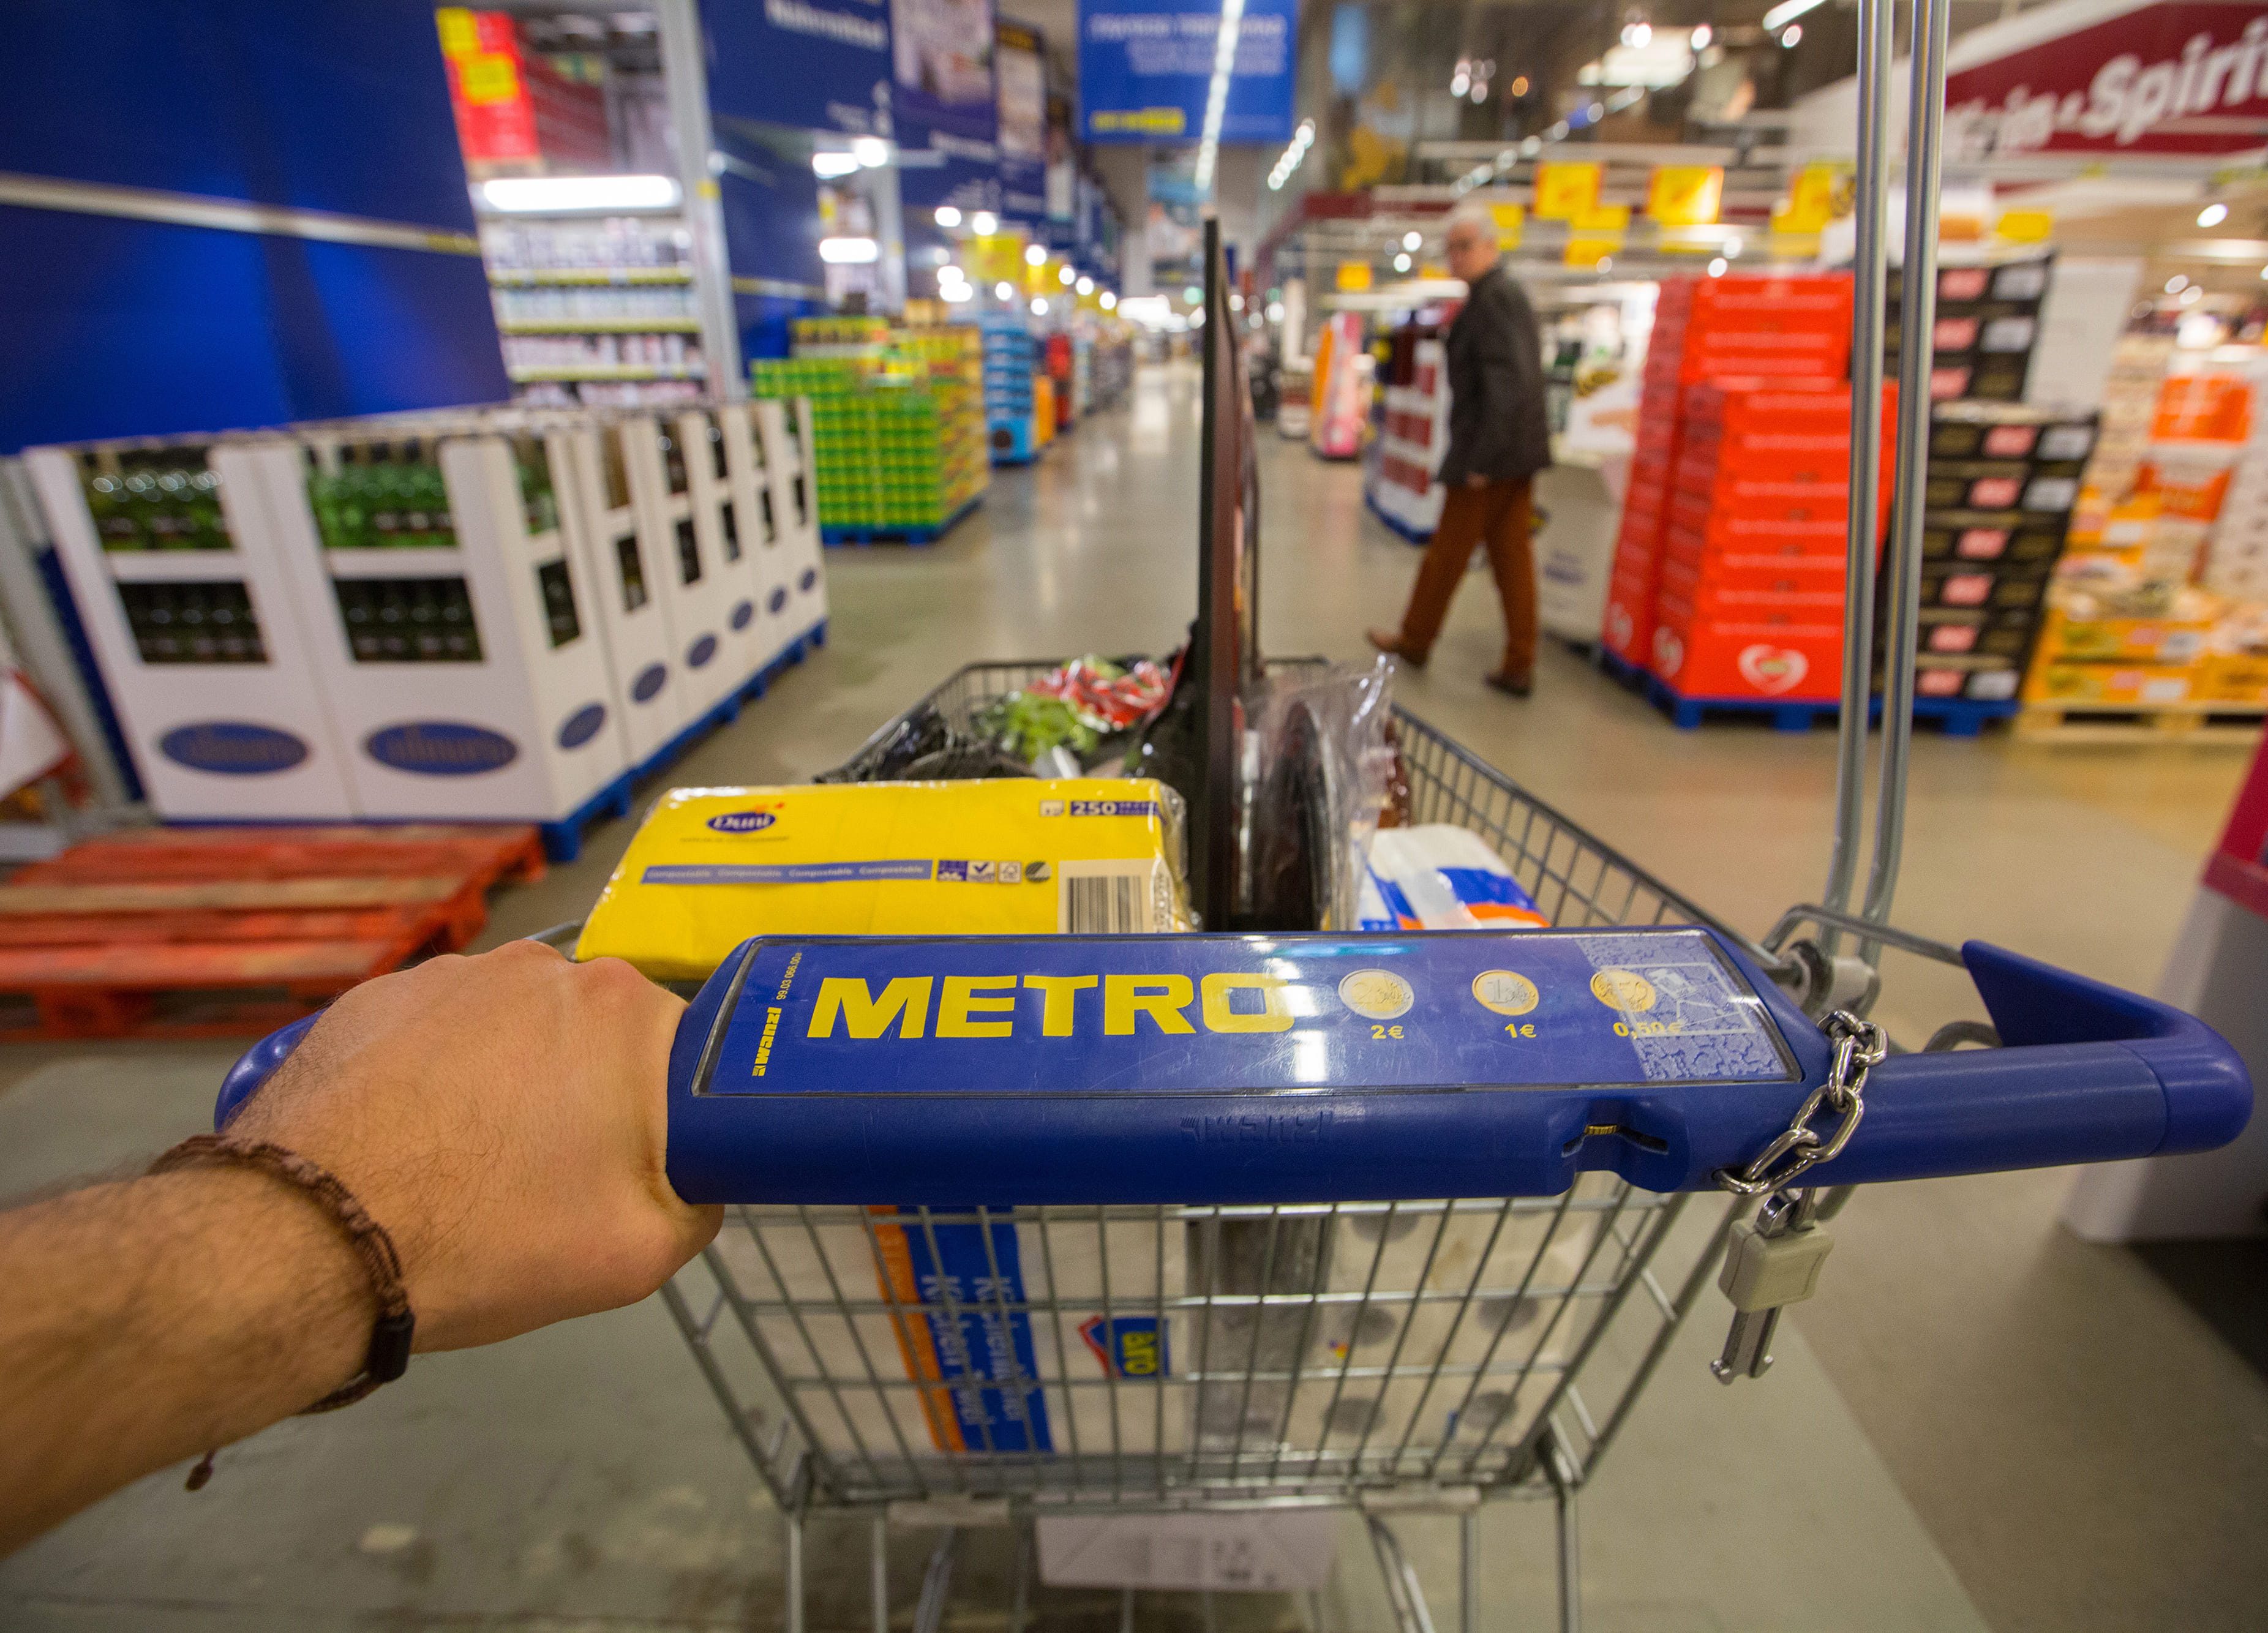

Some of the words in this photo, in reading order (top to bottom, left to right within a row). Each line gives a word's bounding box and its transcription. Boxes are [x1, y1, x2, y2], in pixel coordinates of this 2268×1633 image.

[2083, 15, 2268, 146] Spiri
[1073, 802, 1117, 815] 250
[713, 814, 770, 828] Duni
[776, 979, 792, 1000] 99.03
[807, 973, 1295, 1038] METRO
[1370, 1024, 1405, 1040] 2€
[1504, 1023, 1537, 1038] 1€
